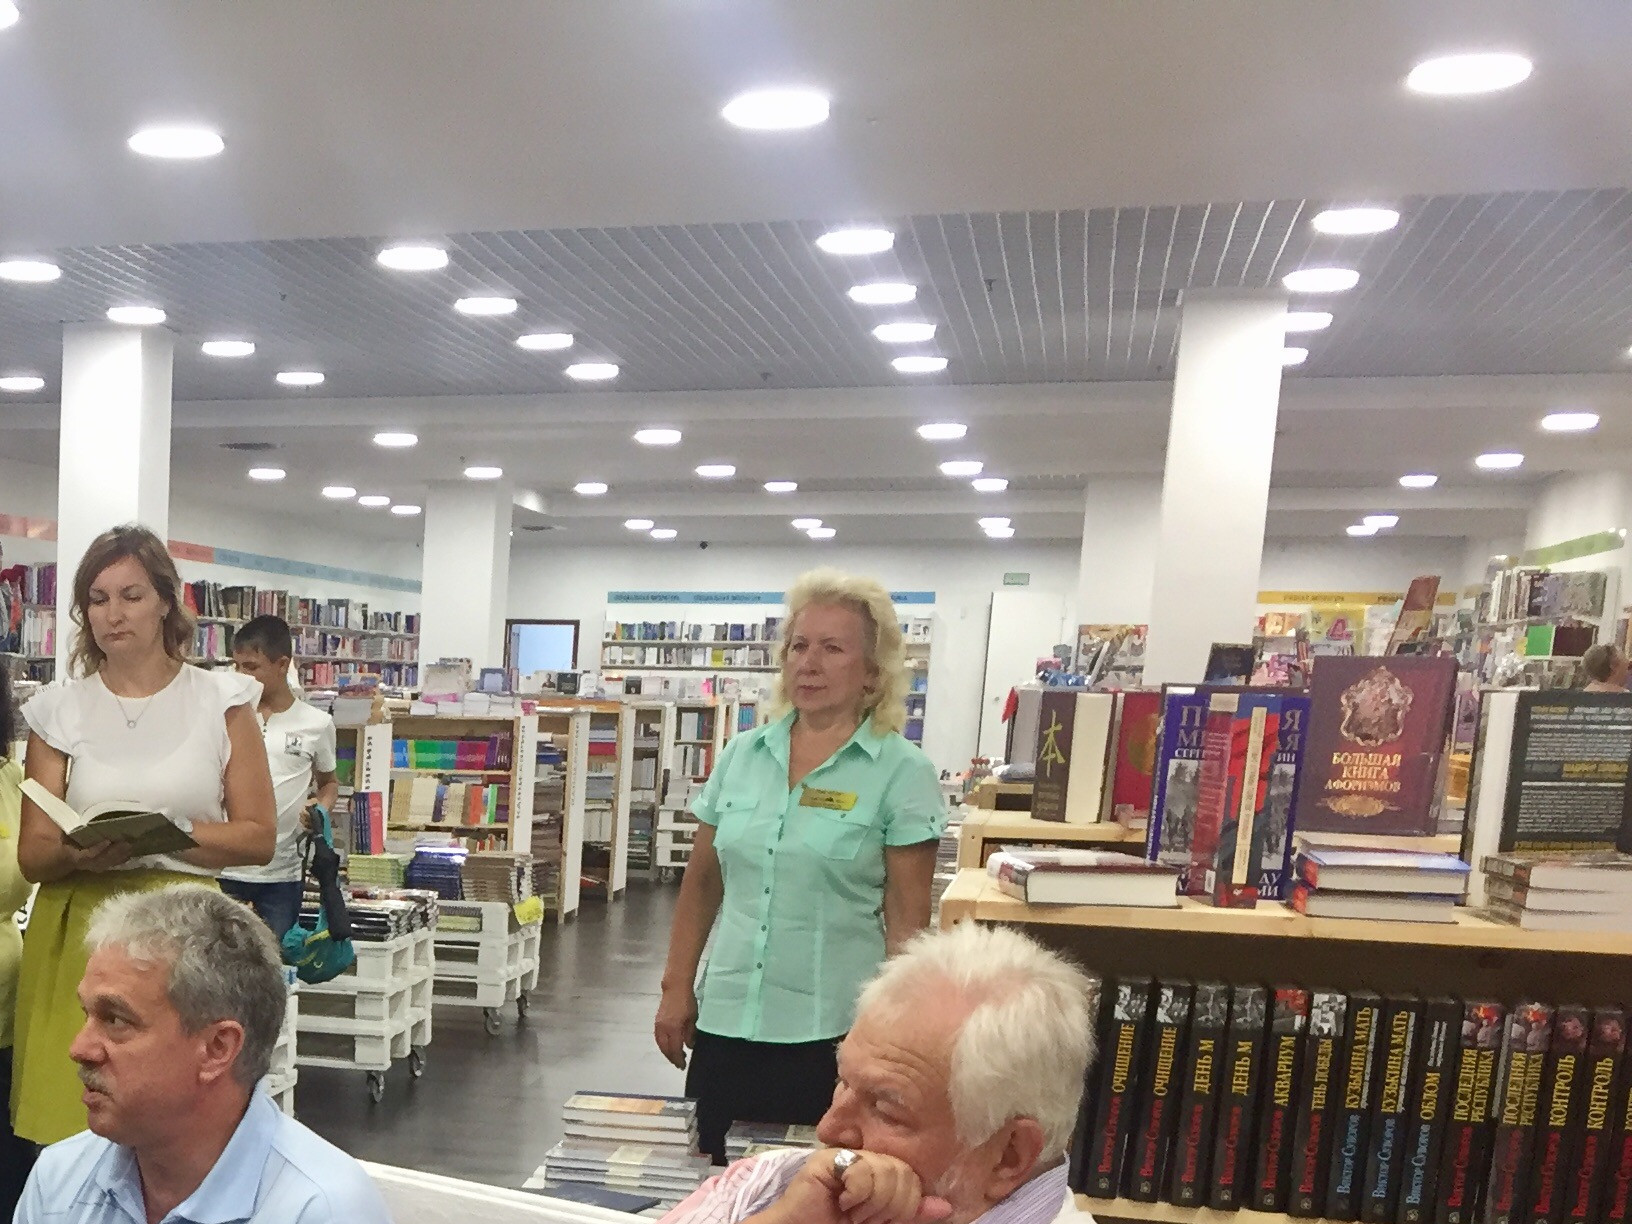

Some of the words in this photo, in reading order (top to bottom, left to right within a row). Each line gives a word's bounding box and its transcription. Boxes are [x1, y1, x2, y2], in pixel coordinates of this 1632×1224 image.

[1332, 752, 1402, 767] БОЛЬШАЯ
[1342, 766, 1389, 779] КНИГА
[1325, 779, 1401, 792] АФОРИЗМОВ
[1198, 1039, 1214, 1052] М
[1236, 1040, 1253, 1053] М
[1354, 1007, 1371, 1040] МАТЬ
[1390, 1010, 1407, 1045] МАТЬ
[1112, 1023, 1135, 1093] ОЧИЩЕНИЕ
[1153, 1026, 1177, 1096] ОЧИЩЕНИЕ
[1193, 1055, 1212, 1094] ДЕНЬ
[1232, 1056, 1250, 1096] ДЕНЬ
[1274, 1036, 1296, 1106] АКВАРИУМ
[1315, 1039, 1332, 1082] ПОБЕДЫ
[1345, 1043, 1367, 1109] КУЗЬКИНА
[1381, 1047, 1404, 1113] КУЗЬКИНА
[1311, 1084, 1327, 1111] ТЕНЬ
[1420, 1072, 1440, 1120] ОБЛОМ
[1453, 1048, 1478, 1121] ПОСЛЕДНЯЯ
[1470, 1050, 1494, 1122] РЕСПУБЛИКА
[1502, 1051, 1527, 1125] ПОСЛЕДНЯЯ
[1520, 1053, 1543, 1126] РЕСПУБЛИКА
[1548, 1054, 1576, 1126] КОНТРОЛЬ
[1586, 1057, 1614, 1130] КОНТРОЛЬ
